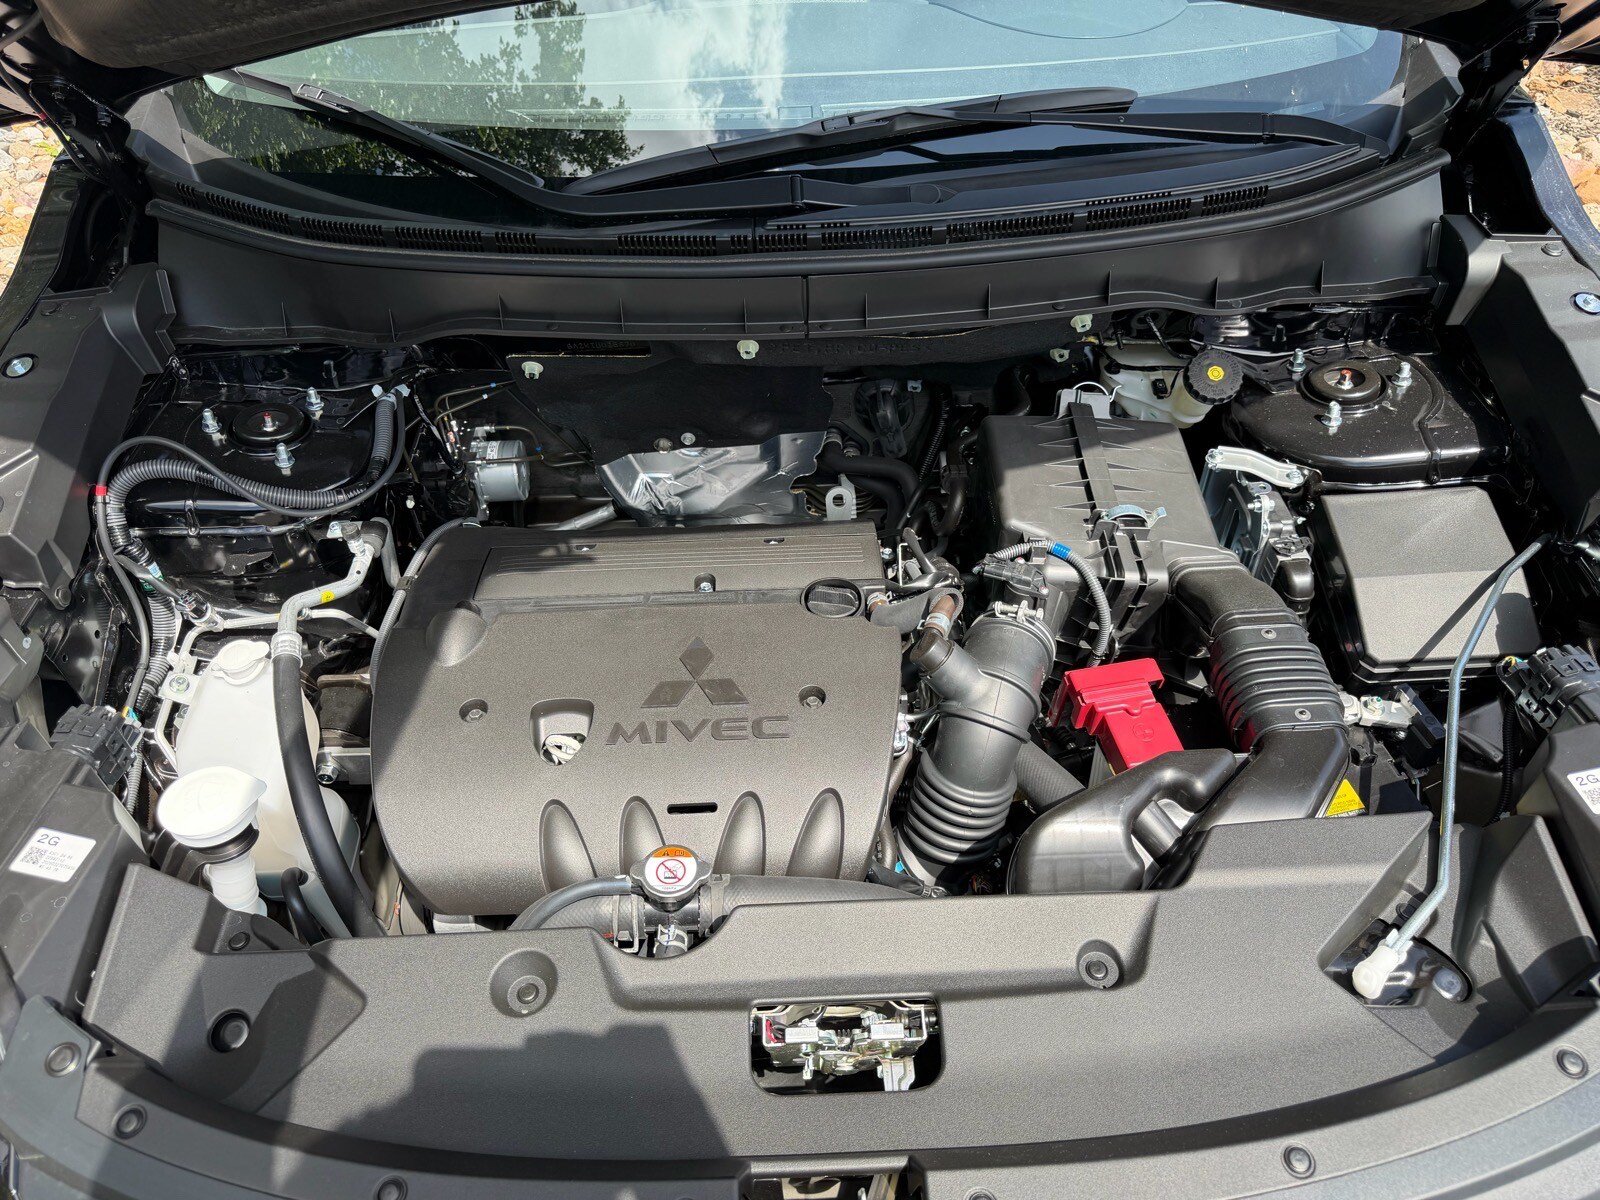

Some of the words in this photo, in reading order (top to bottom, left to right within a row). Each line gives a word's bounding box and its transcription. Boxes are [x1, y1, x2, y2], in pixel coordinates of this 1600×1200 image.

[606, 716, 789, 745] MIVEC
[1576, 774, 1600, 786] 2G
[37, 833, 61, 847] 2G
